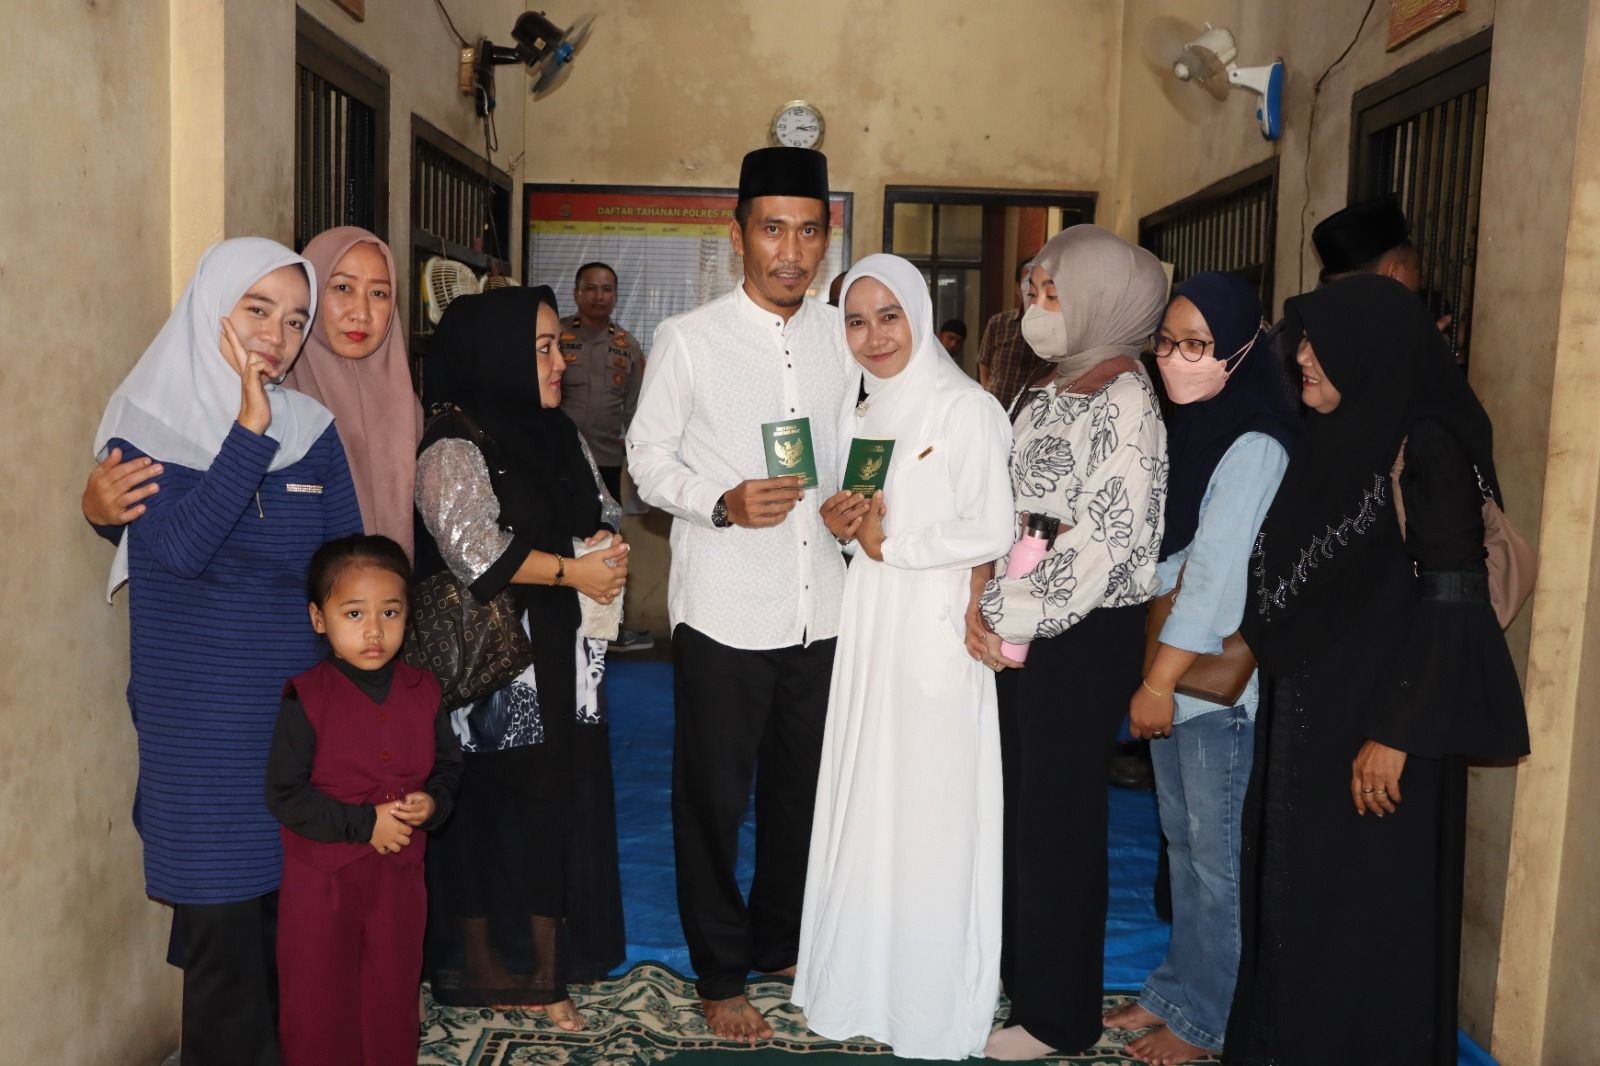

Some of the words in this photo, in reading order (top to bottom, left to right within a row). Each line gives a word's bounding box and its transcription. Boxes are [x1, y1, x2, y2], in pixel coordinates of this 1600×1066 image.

[597, 207, 633, 215] DAFTAR
[637, 208, 680, 216] TAHANAN
[683, 208, 718, 217] POLRES
